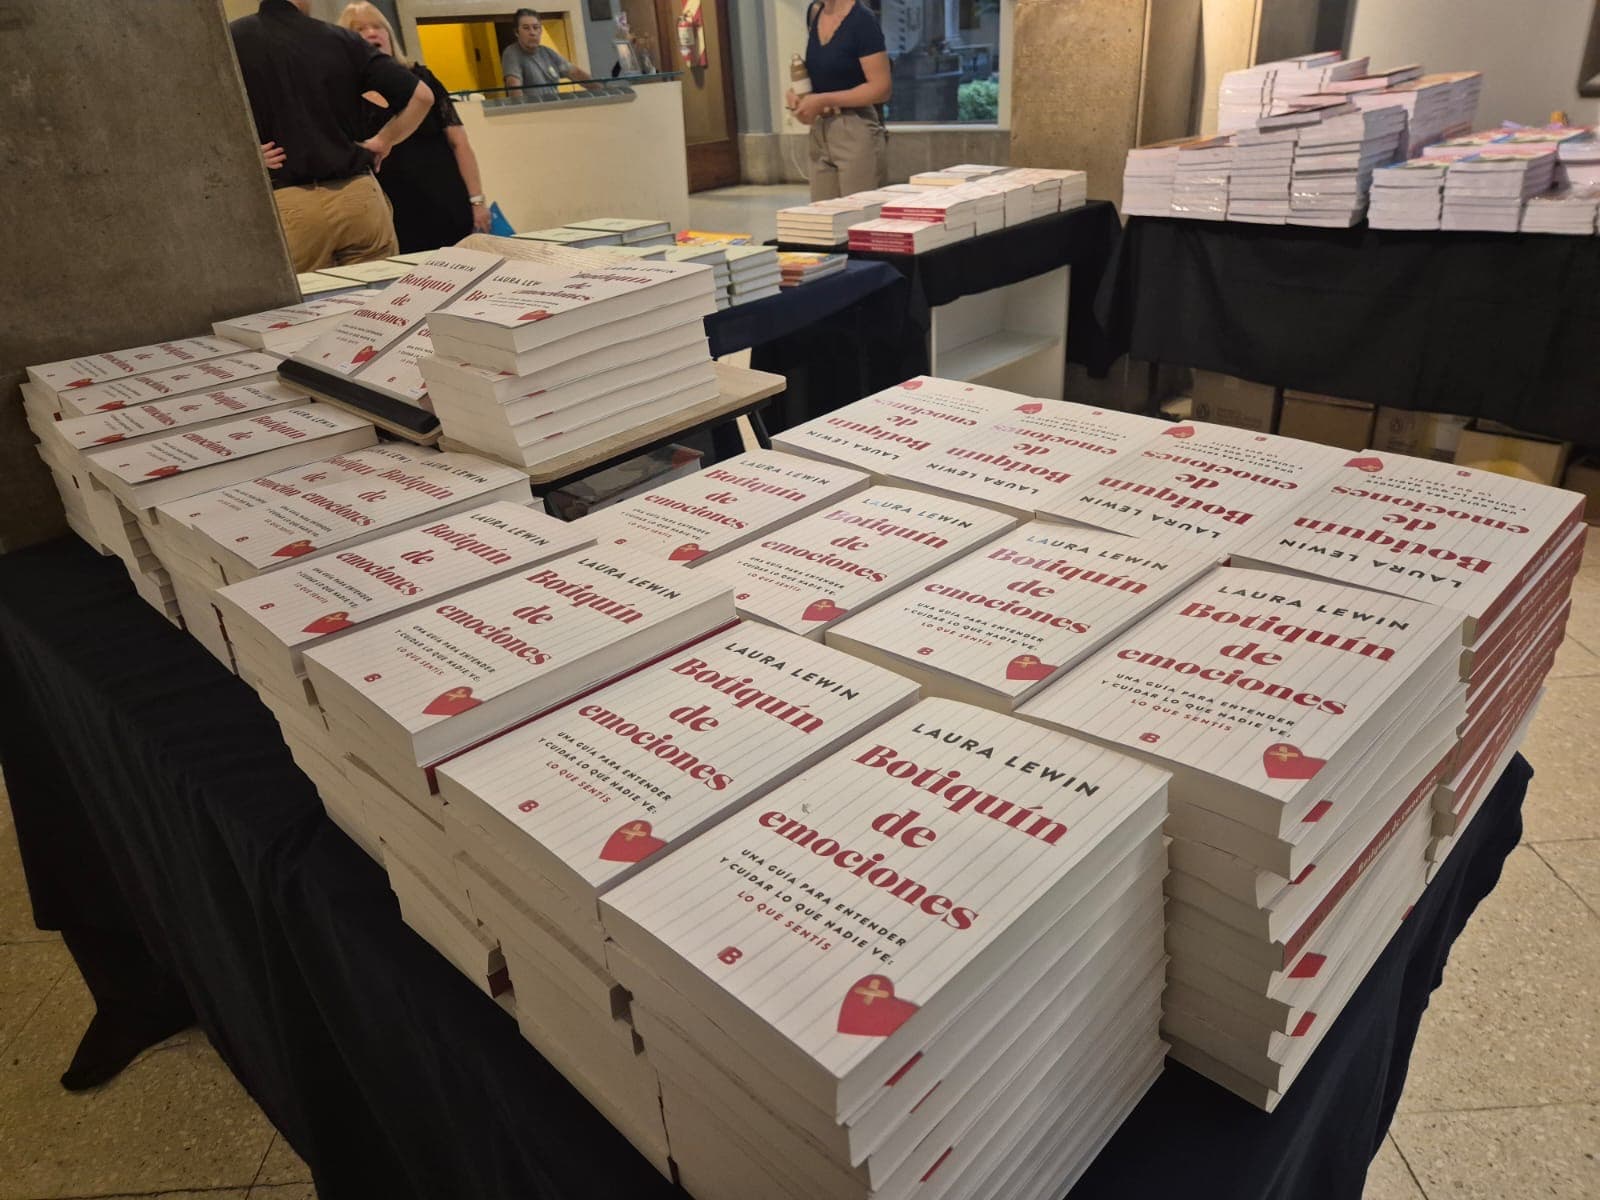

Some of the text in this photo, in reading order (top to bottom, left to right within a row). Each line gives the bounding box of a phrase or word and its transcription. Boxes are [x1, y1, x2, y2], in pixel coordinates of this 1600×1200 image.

[990, 424, 1118, 454] emociones
[1013, 443, 1050, 456] de
[1141, 449, 1300, 490] emociones
[1175, 474, 1219, 490] de
[644, 495, 749, 529] emociones
[705, 491, 738, 505] de
[861, 499, 974, 527] LAURA LEWIN
[1080, 495, 1221, 538] LAURA LEWIN
[1099, 475, 1255, 524] Botiquín
[1331, 485, 1531, 533] emociones
[419, 524, 514, 564] Botiquín
[468, 514, 552, 545] LAURA LEWIN
[822, 510, 950, 547] Botiquín
[830, 535, 869, 551] de
[1294, 515, 1493, 572] Botiquín
[1382, 514, 1436, 532] de
[337, 551, 424, 595] emociones
[400, 549, 435, 565] de
[761, 540, 888, 581] emociones
[986, 549, 1148, 594] Botiquín
[1026, 537, 1169, 570] LAURA LEWIN
[1279, 537, 1461, 587] LAURA LEWIN
[524, 571, 643, 624] Botiquín
[577, 559, 681, 599] LAURA LEWIN
[1007, 579, 1055, 598] de
[512, 605, 554, 625] de
[924, 583, 1092, 633] emociones
[1219, 587, 1410, 629] LAURA LEWIN
[436, 605, 553, 665] emociones
[1178, 602, 1396, 661] Botiquín
[725, 643, 860, 699] LAURA LEWIN
[1220, 642, 1282, 666] de
[670, 658, 825, 733] Botiquín
[1116, 648, 1348, 714] emociones
[1116, 673, 1295, 726] UNA GUÍA PARA ENTENDER
[669, 705, 719, 732] de
[1111, 683, 1159, 699] CUIDAR
[1185, 703, 1213, 714] QUE
[1218, 713, 1263, 728] NADIE
[1152, 705, 1180, 716] QUE
[1183, 714, 1232, 731] SENTÍS
[558, 731, 671, 800] UNA GUÍA PARA ENTENDER
[579, 704, 734, 789] emociones
[912, 724, 1100, 797] LAURA LEWIN
[545, 741, 577, 762] CUIDAR
[576, 760, 590, 769] LO
[590, 769, 610, 782] QUE
[610, 781, 641, 801] NADIE
[546, 761, 611, 803] LO QUE SENTÍS
[854, 745, 1068, 846] Botiquín
[872, 809, 936, 848] de
[759, 811, 979, 930] emociones
[730, 864, 773, 891] CUIDAR
[774, 891, 792, 902] LO
[795, 903, 823, 921] QUE
[824, 920, 868, 948] NADIE
[742, 849, 906, 947] UNA GUÍA PARA ENTENDER
[737, 891, 831, 950] LO QUE SENTÍS
